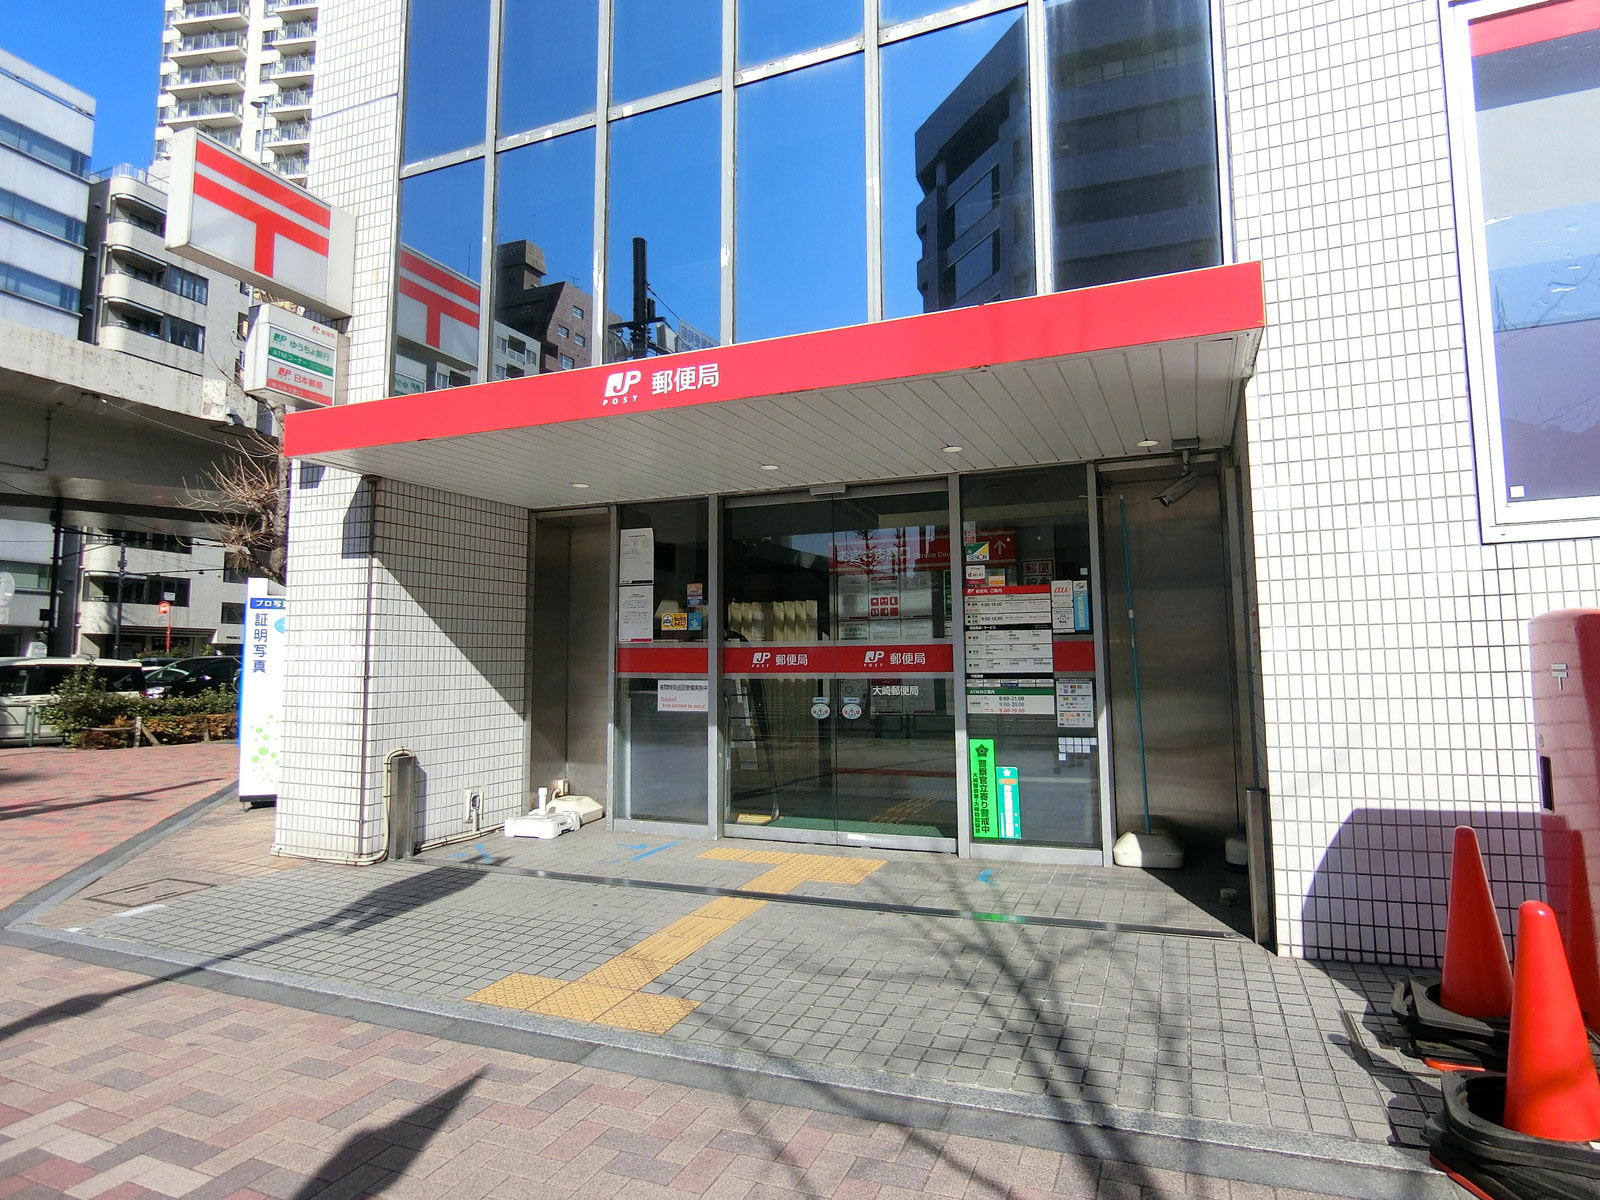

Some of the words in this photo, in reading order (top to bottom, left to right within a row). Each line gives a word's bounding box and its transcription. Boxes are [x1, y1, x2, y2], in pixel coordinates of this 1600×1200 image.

[271, 349, 308, 365] ATMコーナー
[289, 340, 330, 361] ゆうちょ銀行
[294, 374, 324, 390] 日本郵便
[652, 363, 719, 395] 郵便局
[602, 395, 638, 406] POST
[252, 613, 268, 673] 証明写真
[775, 654, 808, 666] 郵便局
[889, 652, 926, 665] 郵便局
[872, 685, 919, 696] 大崎郵便局
